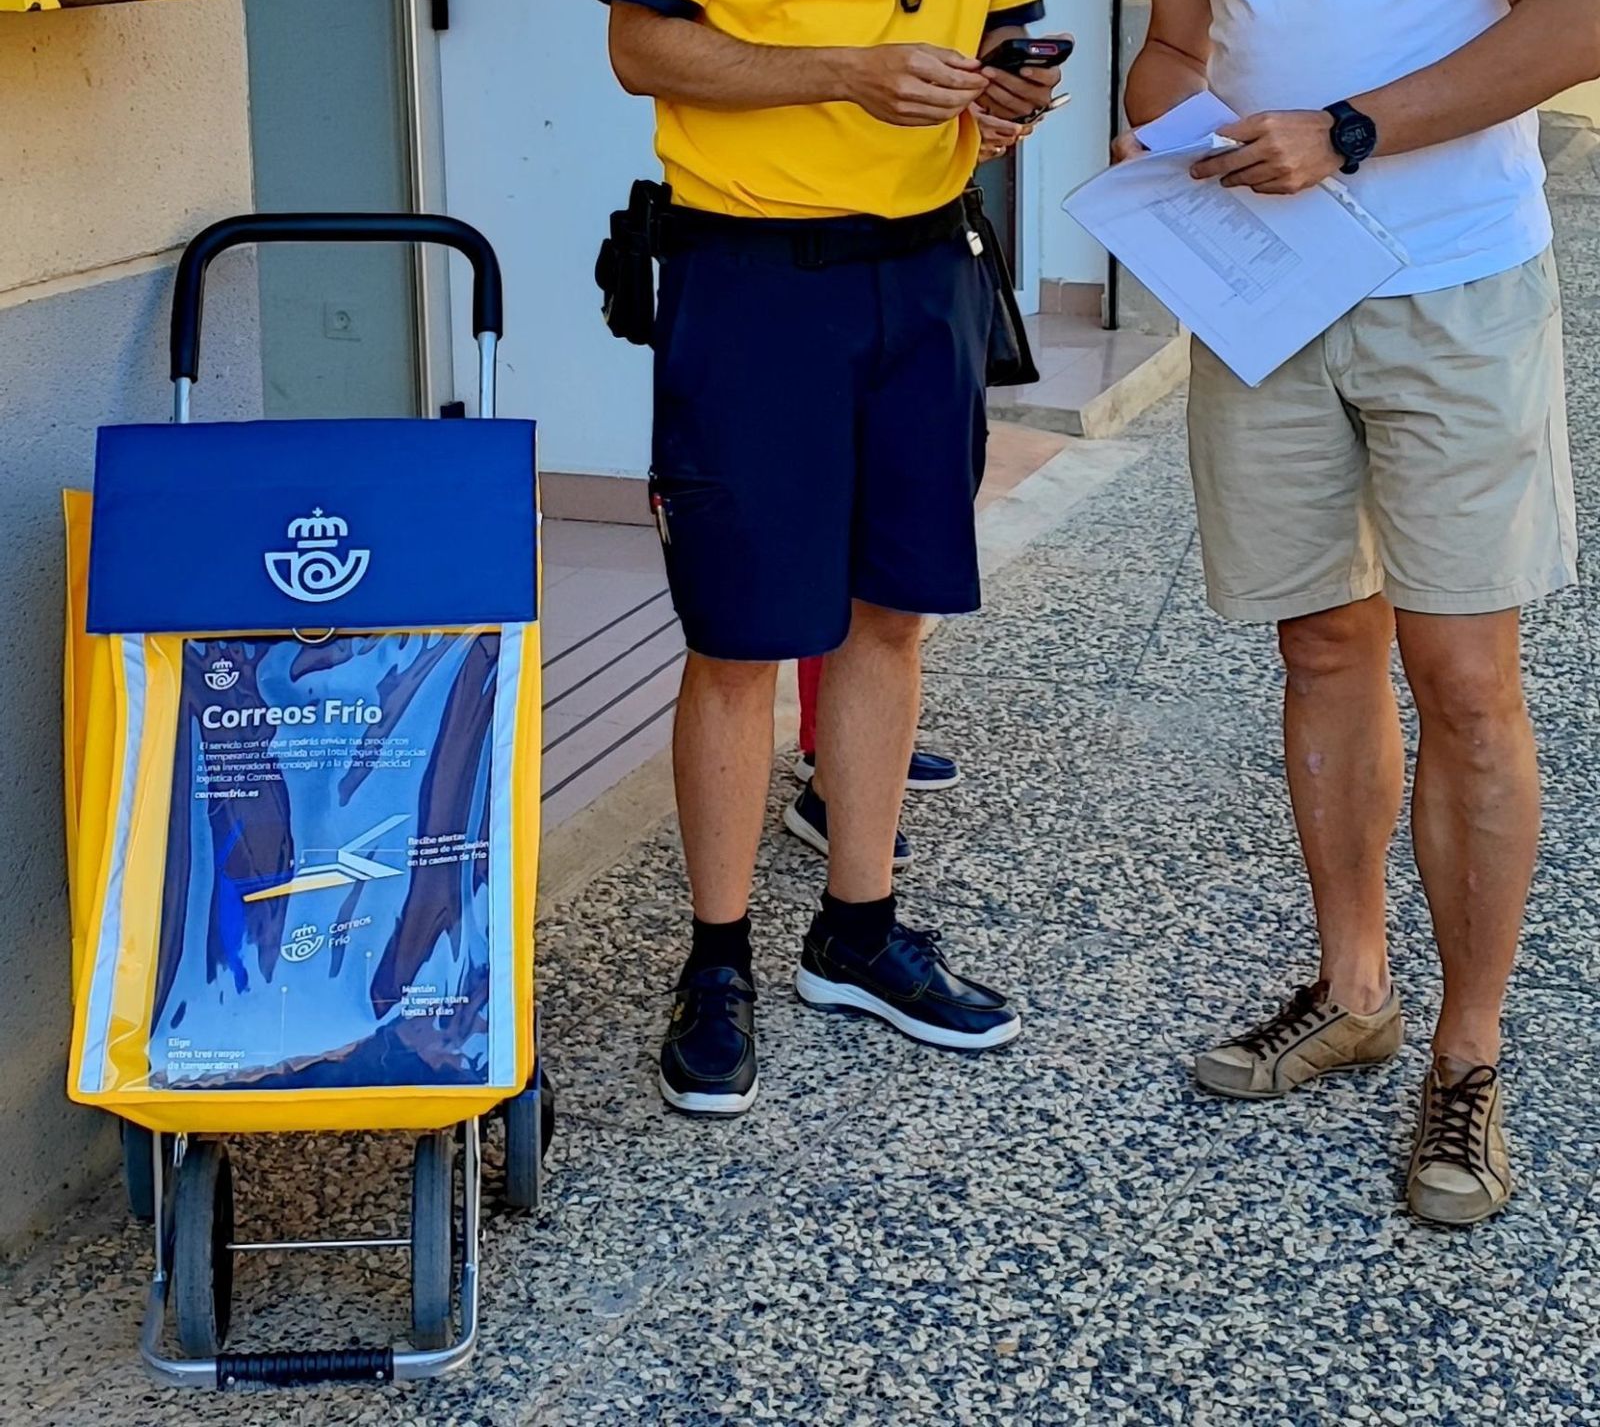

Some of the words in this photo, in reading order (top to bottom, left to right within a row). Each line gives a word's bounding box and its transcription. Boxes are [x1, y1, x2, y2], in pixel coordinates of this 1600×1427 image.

[202, 705, 317, 729] Correos
[324, 698, 383, 724] Frío
[200, 741, 208, 750] El
[209, 740, 242, 750] servicio
[243, 740, 259, 749] con
[260, 739, 269, 748] el
[270, 739, 287, 749] que
[320, 738, 347, 746] enviar
[364, 737, 410, 747] productos
[205, 751, 260, 762] temperatura
[261, 749, 308, 759] controlada
[309, 749, 326, 757] con
[327, 748, 348, 756] total
[350, 748, 393, 758] seguridad
[395, 748, 427, 758] gracias
[204, 764, 220, 772] una
[222, 762, 271, 772] innovadora
[272, 760, 318, 770] tecnología
[320, 760, 326, 769] y
[333, 759, 342, 768] la
[343, 760, 364, 769] gran
[365, 759, 411, 768] capacidad
[196, 774, 232, 784] logística
[234, 774, 245, 782] de
[246, 773, 283, 782] Correos.
[407, 836, 437, 846] Recibe
[438, 834, 466, 843] alertas
[440, 845, 451, 853] de
[419, 858, 428, 866] la
[428, 855, 458, 866] cadena
[459, 852, 470, 861] de
[328, 916, 372, 934] Correos
[327, 934, 351, 949] Frío
[401, 997, 410, 1005] la
[411, 995, 469, 1007] temperatura
[401, 1007, 427, 1017] hasta
[168, 1037, 191, 1048] Elige
[168, 1050, 192, 1058] entre
[194, 1050, 212, 1058] tres
[214, 1050, 246, 1060] rangos
[167, 1062, 179, 1070] de
[180, 1062, 239, 1070] temperatura
